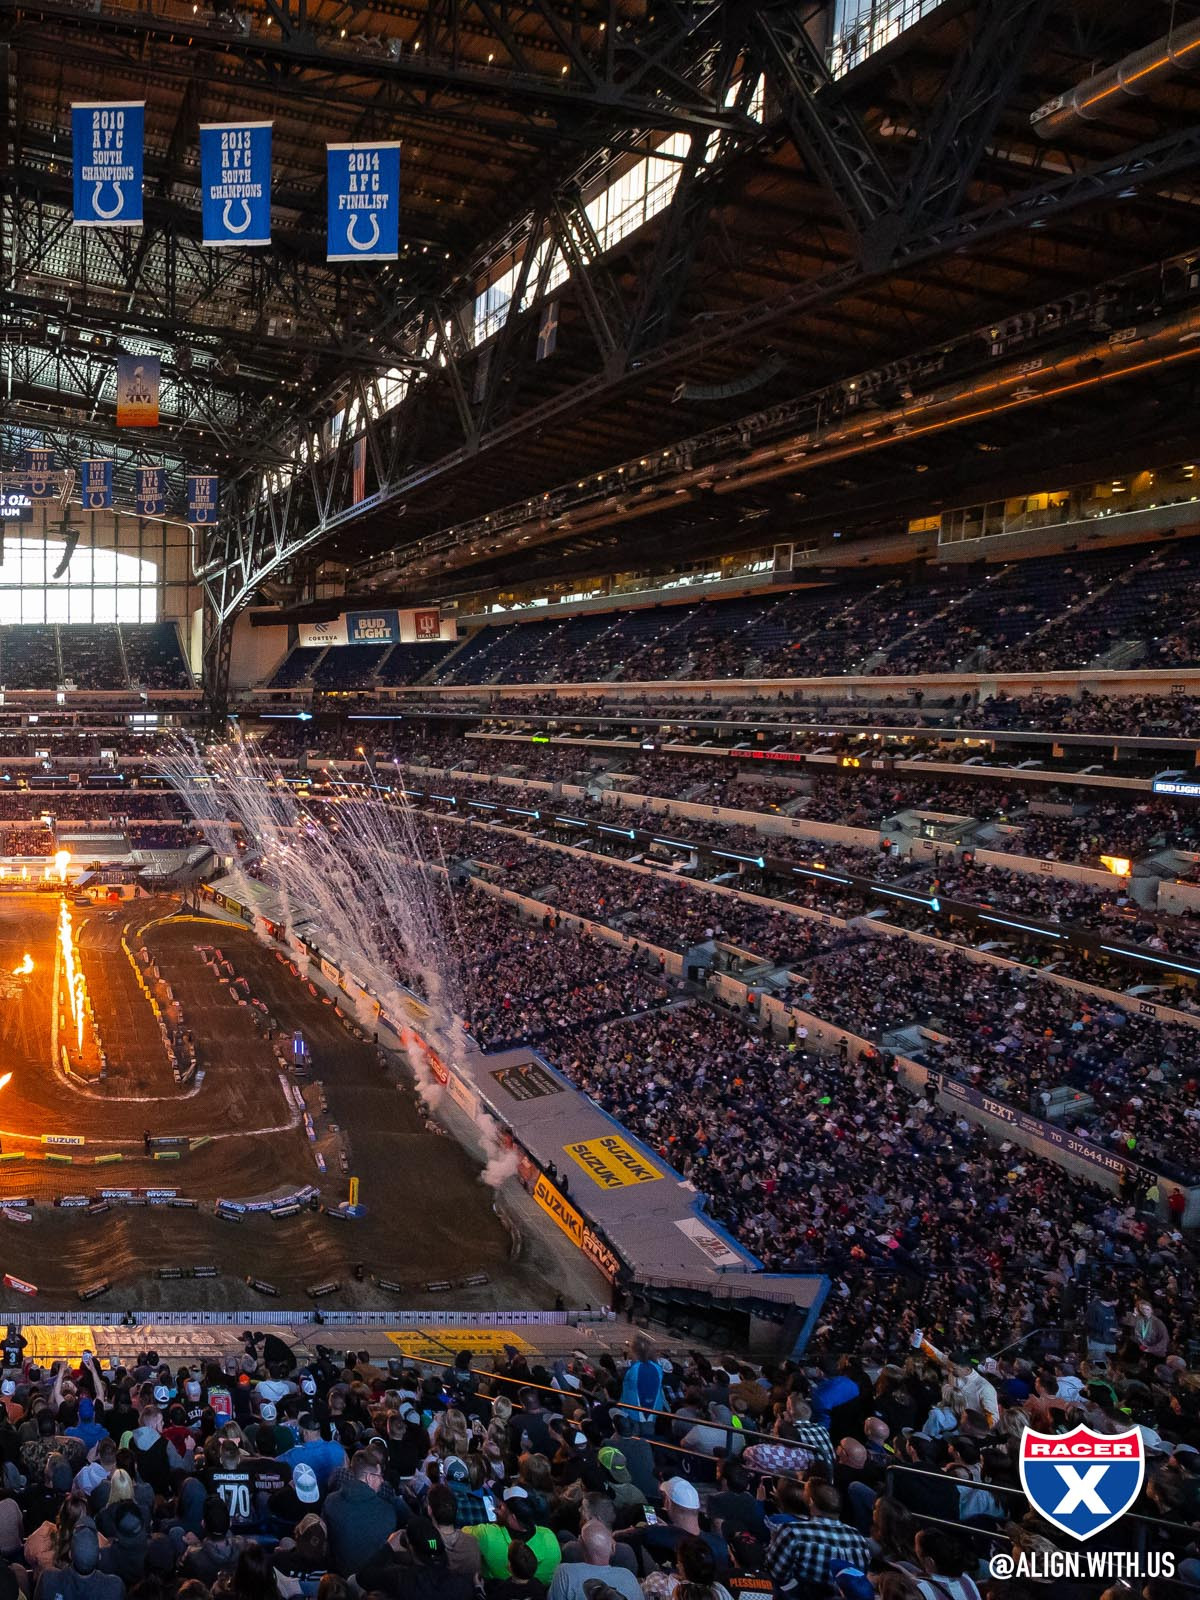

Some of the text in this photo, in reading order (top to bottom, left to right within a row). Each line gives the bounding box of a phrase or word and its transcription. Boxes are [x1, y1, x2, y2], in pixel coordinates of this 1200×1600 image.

[92, 111, 125, 129] 2010
[92, 130, 124, 148] AFC
[221, 131, 251, 150] 2013
[92, 151, 122, 165] SOUTH
[222, 150, 252, 168] AFC
[348, 152, 380, 172] 2014
[82, 166, 134, 181] CHAMPIONS
[222, 169, 252, 184] SOUTH
[349, 173, 380, 192] AFC
[210, 184, 262, 200] CHAMPIONS
[338, 194, 389, 210] FINALIST
[8, 494, 32, 506] OIL
[358, 618, 386, 630] BUD
[354, 628, 392, 640] LIGHT
[1156, 783, 1176, 792] BUD
[1140, 1004, 1155, 1014] 244
[1050, 1132, 1062, 1143] TO
[572, 1144, 624, 1188] SUZUKI
[600, 1138, 655, 1181] SUZUKI
[536, 1182, 582, 1240] SUZUKI
[9, 1352, 16, 1363] 3
[216, 1484, 250, 1518] 170
